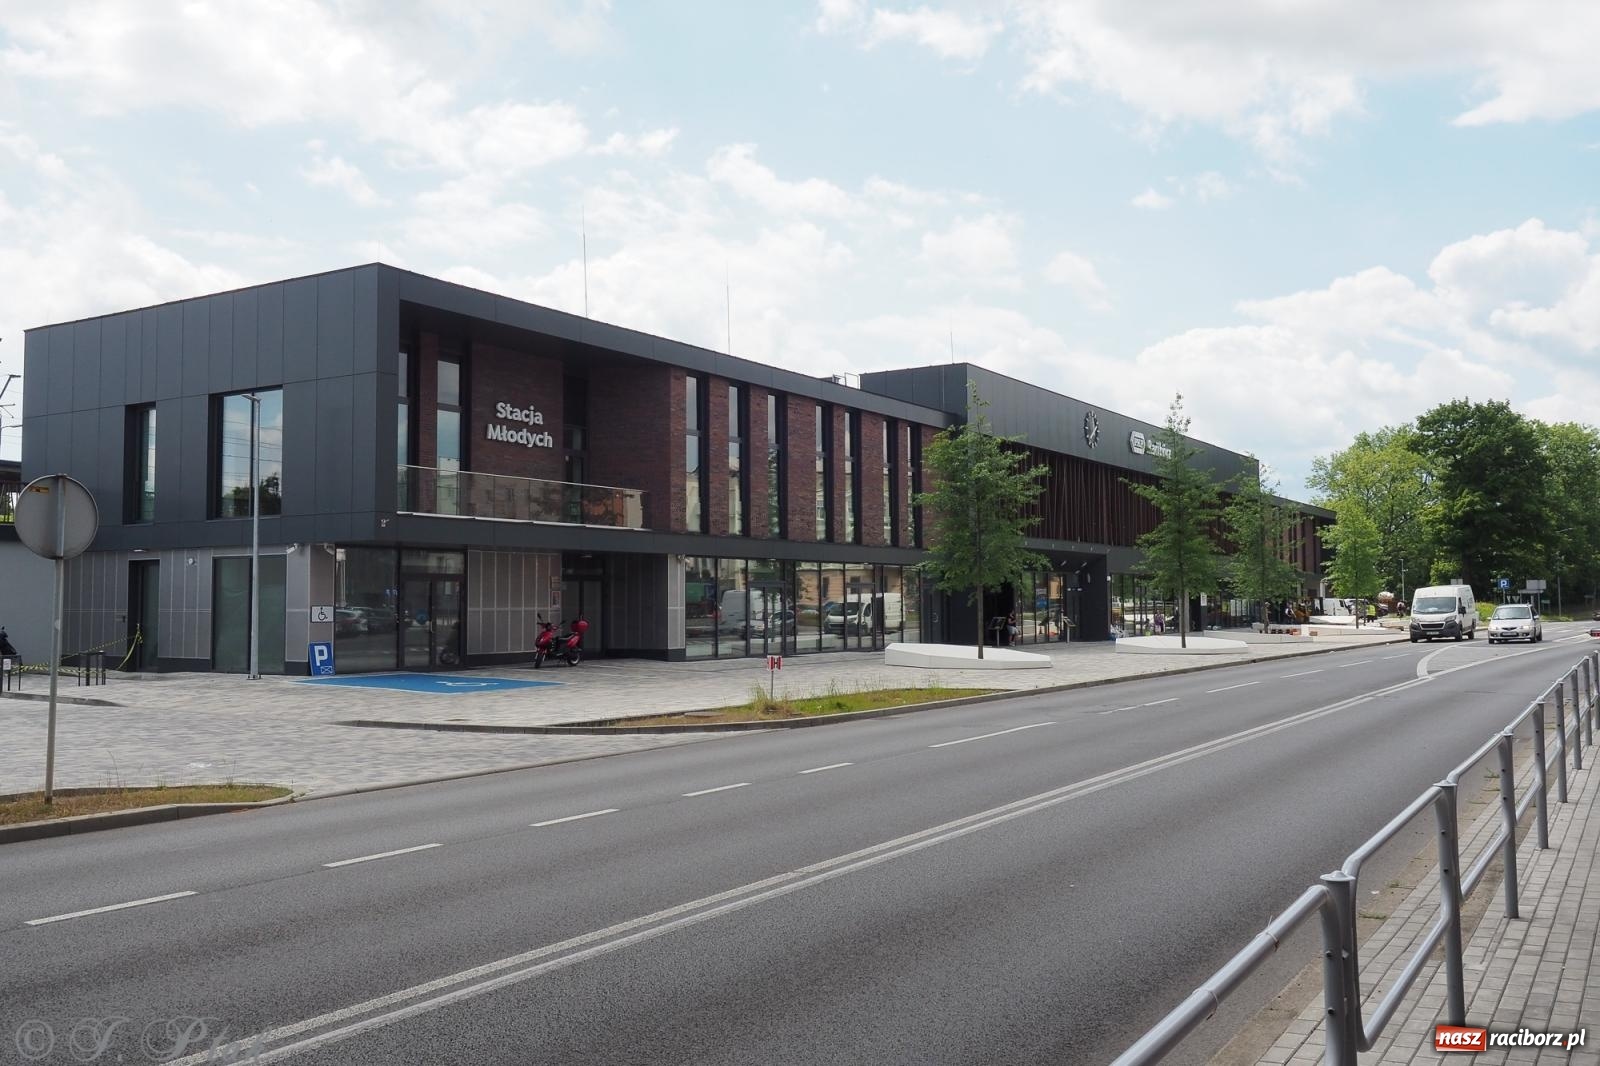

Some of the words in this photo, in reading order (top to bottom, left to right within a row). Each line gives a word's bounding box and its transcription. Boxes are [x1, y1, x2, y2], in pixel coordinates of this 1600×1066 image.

[496, 402, 543, 426] Stacja
[487, 423, 553, 448] Młodych
[314, 645, 328, 666] P
